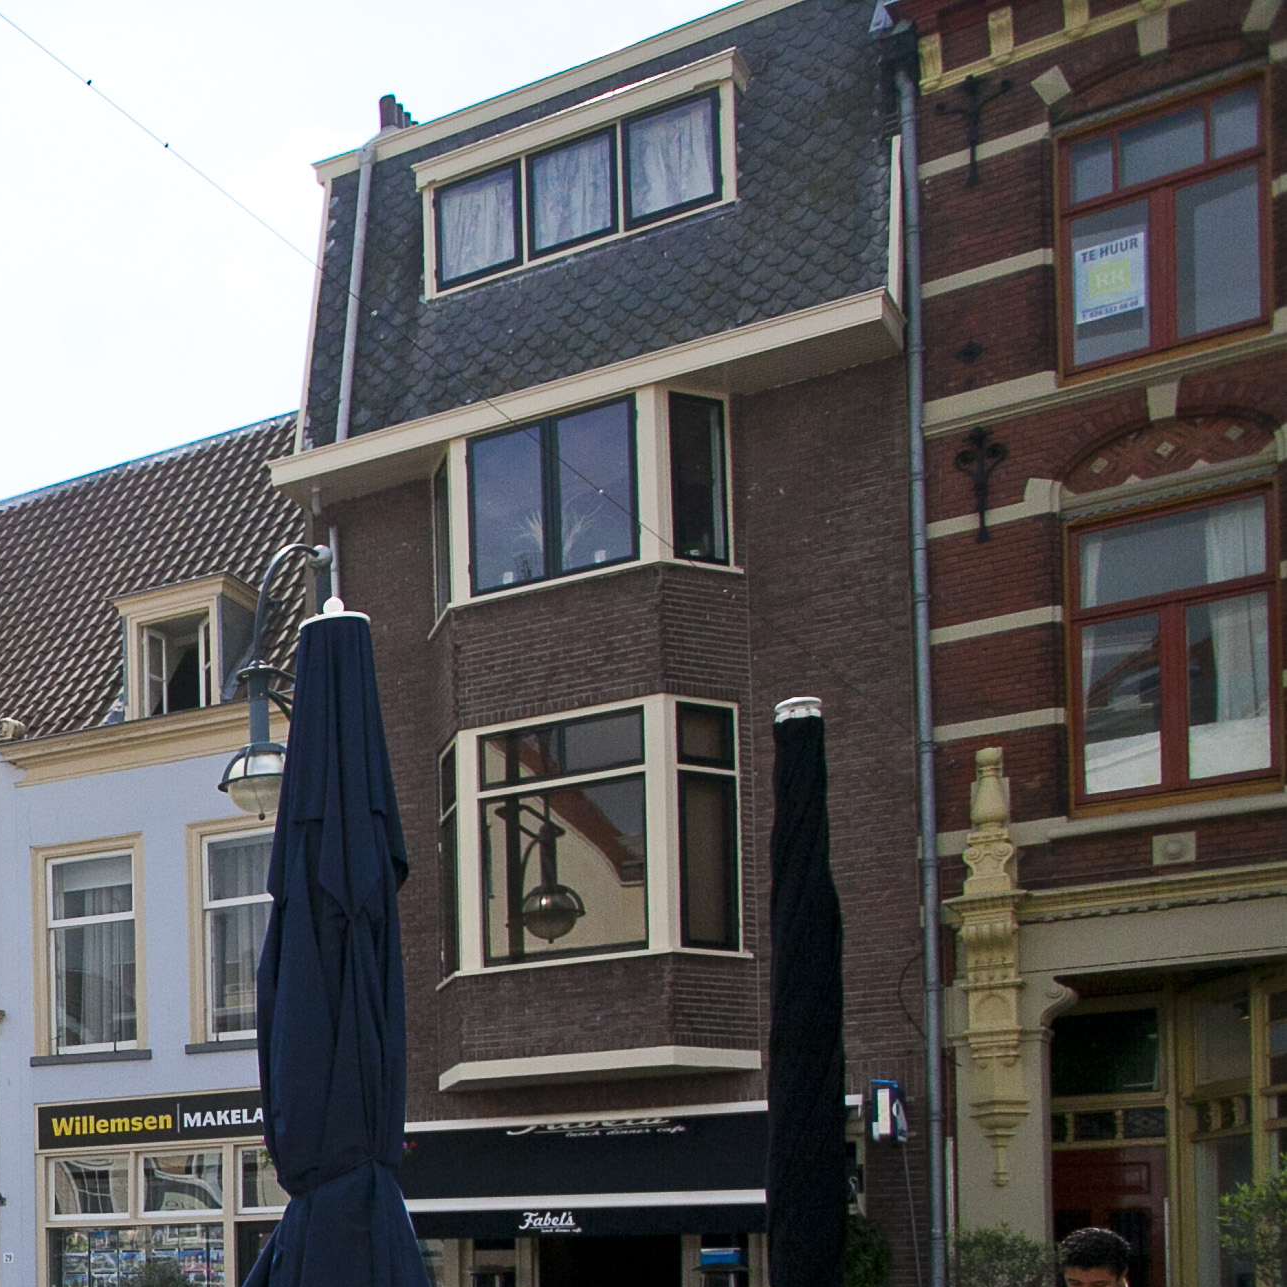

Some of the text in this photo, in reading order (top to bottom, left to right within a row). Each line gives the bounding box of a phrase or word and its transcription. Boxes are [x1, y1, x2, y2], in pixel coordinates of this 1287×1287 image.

[1081, 237, 1139, 263] TE HUUR
[52, 1107, 264, 1137] Willemsen MAKELA
[519, 1211, 576, 1230] Fabel's
